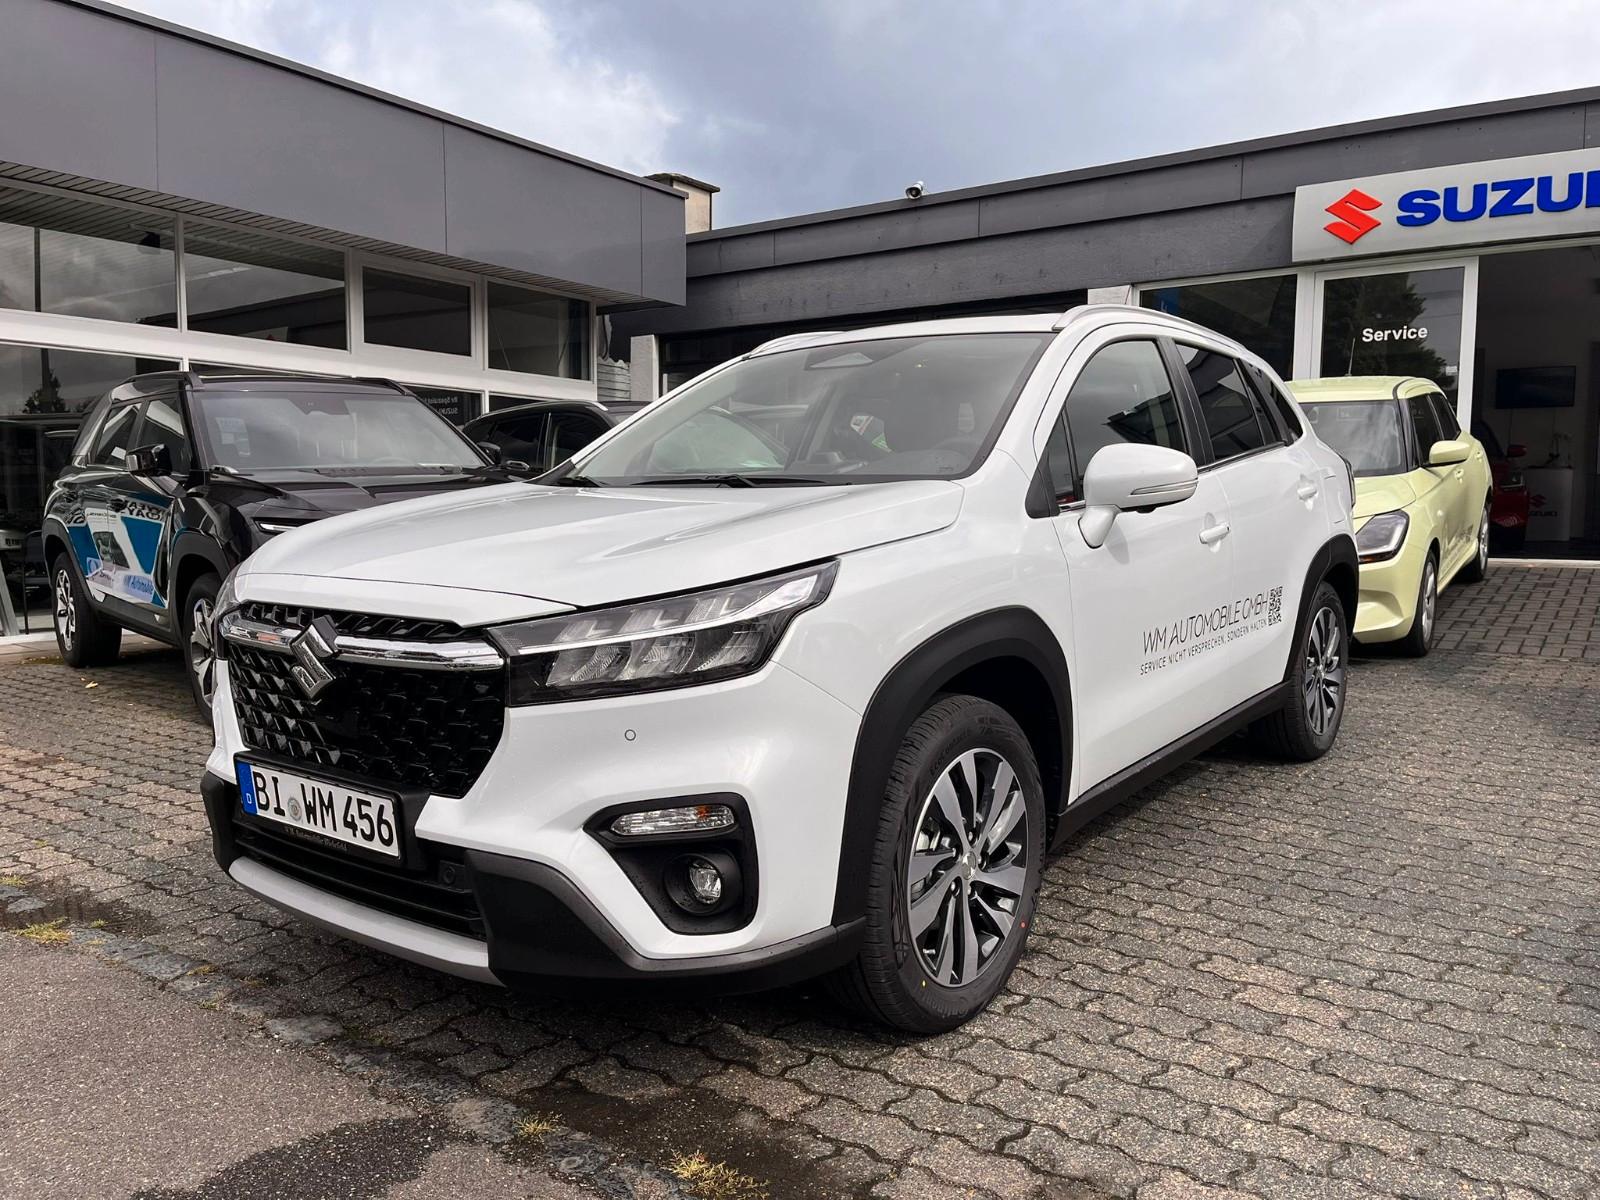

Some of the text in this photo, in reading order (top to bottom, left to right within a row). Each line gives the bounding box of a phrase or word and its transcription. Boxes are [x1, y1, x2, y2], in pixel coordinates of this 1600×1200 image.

[1362, 325, 1428, 343] Service
[1143, 626, 1167, 656] WM
[1168, 600, 1241, 650] AUTOMOBILE
[1140, 656, 1166, 676] SERVICE
[1168, 648, 1187, 664] NICHT
[1187, 635, 1226, 657] VERSPRECHEN,
[245, 793, 253, 804] D
[253, 771, 286, 817] BI
[300, 783, 338, 832] WM
[342, 795, 394, 848] 456
